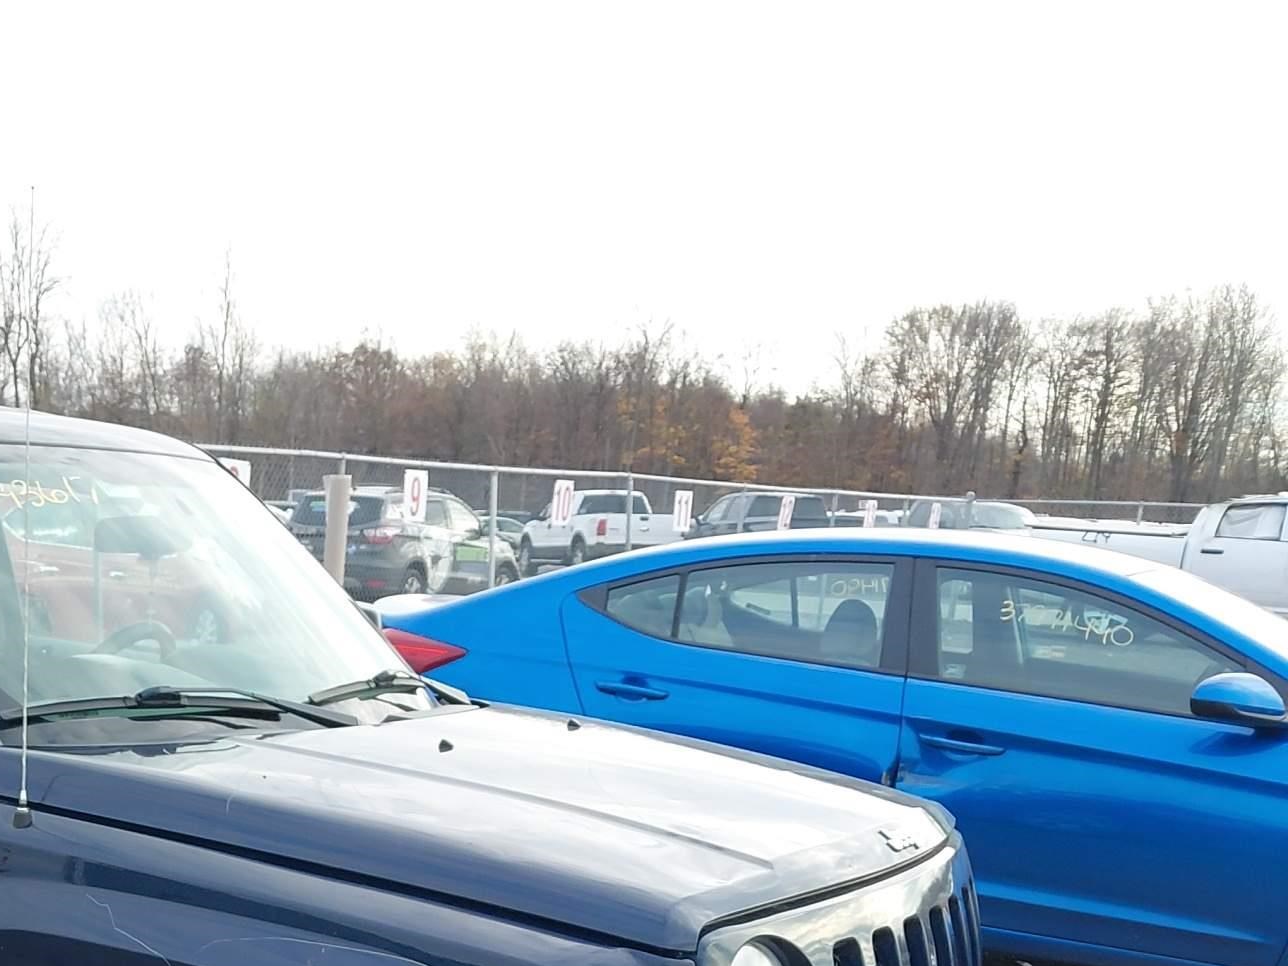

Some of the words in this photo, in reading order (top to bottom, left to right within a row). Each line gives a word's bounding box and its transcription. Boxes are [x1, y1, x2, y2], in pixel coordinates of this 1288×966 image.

[411, 476, 421, 516] 9
[555, 485, 572, 521] 10
[677, 494, 690, 528] 11
